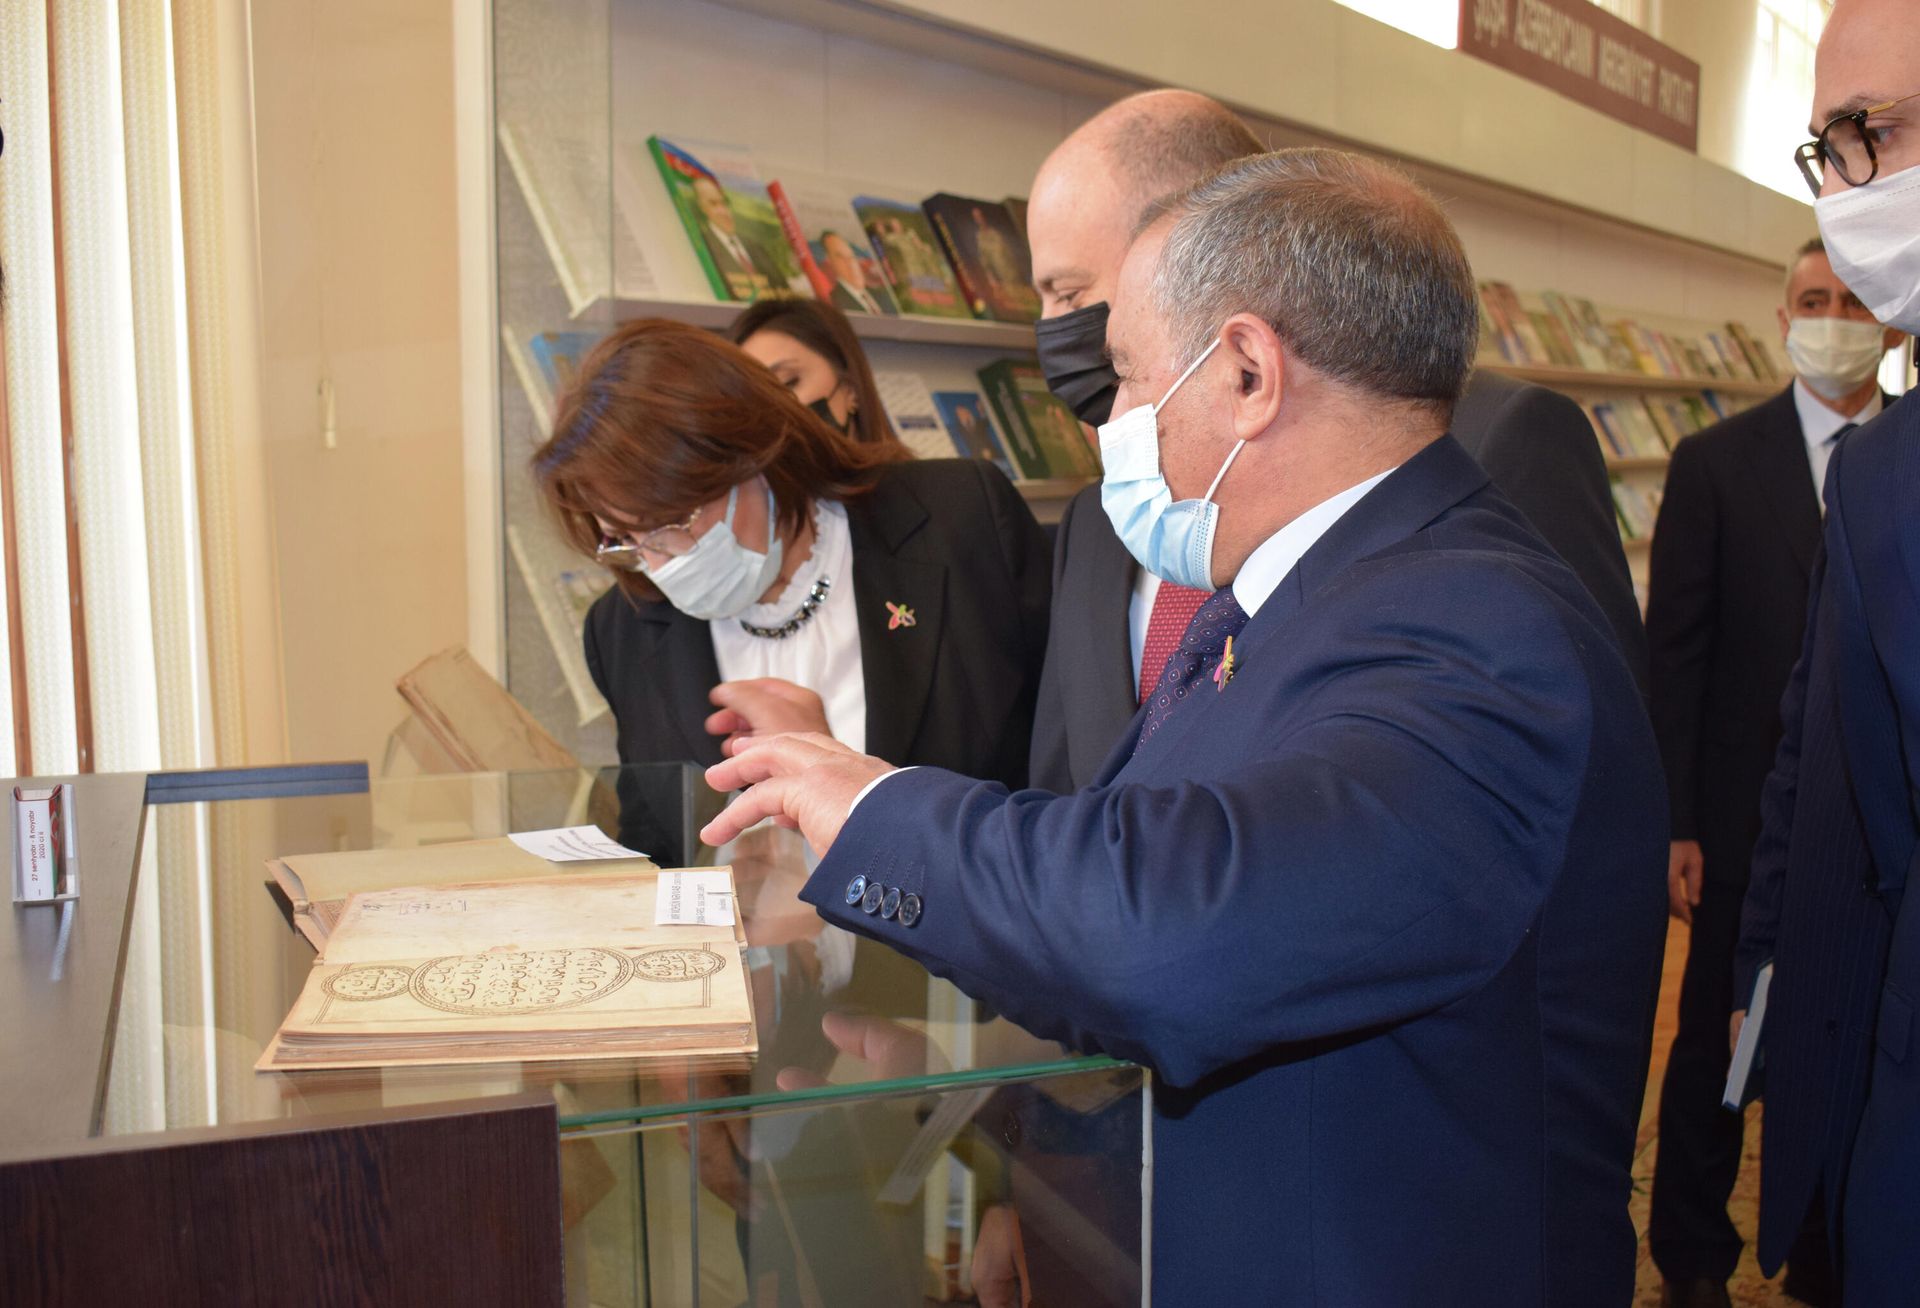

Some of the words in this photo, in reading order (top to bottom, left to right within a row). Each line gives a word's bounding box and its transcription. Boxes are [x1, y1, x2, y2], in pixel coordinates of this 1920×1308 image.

[28, 810, 36, 834] noyabr
[30, 844, 38, 873] sentyabr
[38, 843, 46, 859] 2020
